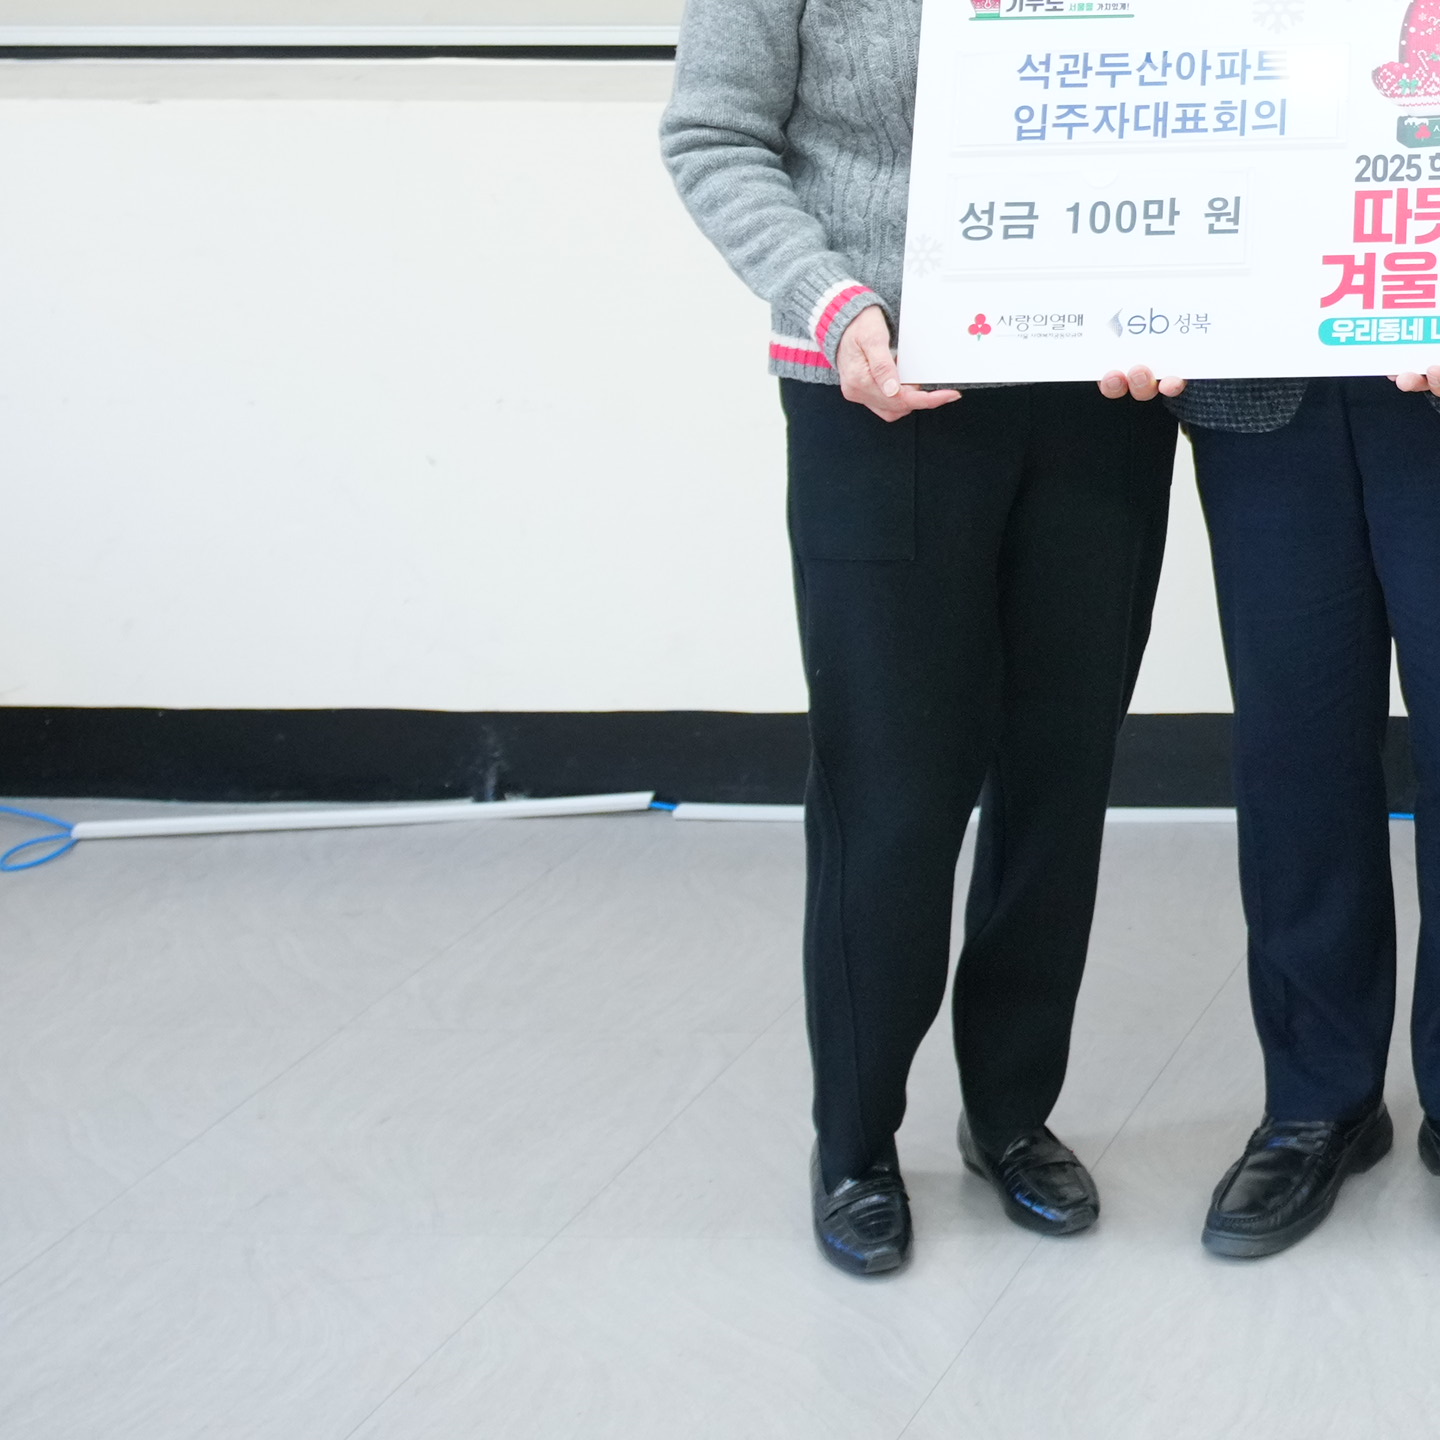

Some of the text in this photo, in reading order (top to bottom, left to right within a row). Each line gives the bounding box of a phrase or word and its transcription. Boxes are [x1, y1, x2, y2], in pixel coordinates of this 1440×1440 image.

[1017, 49, 1287, 89] 석관두산아파트
[1015, 99, 1286, 141] 입주자대표회의
[1355, 154, 1421, 182] 2025
[959, 196, 1240, 241] 성금 100만 원
[996, 313, 1084, 332] 사랑의열매
[1127, 307, 1212, 335] sb 성북
[1332, 318, 1423, 342] 우리동네
